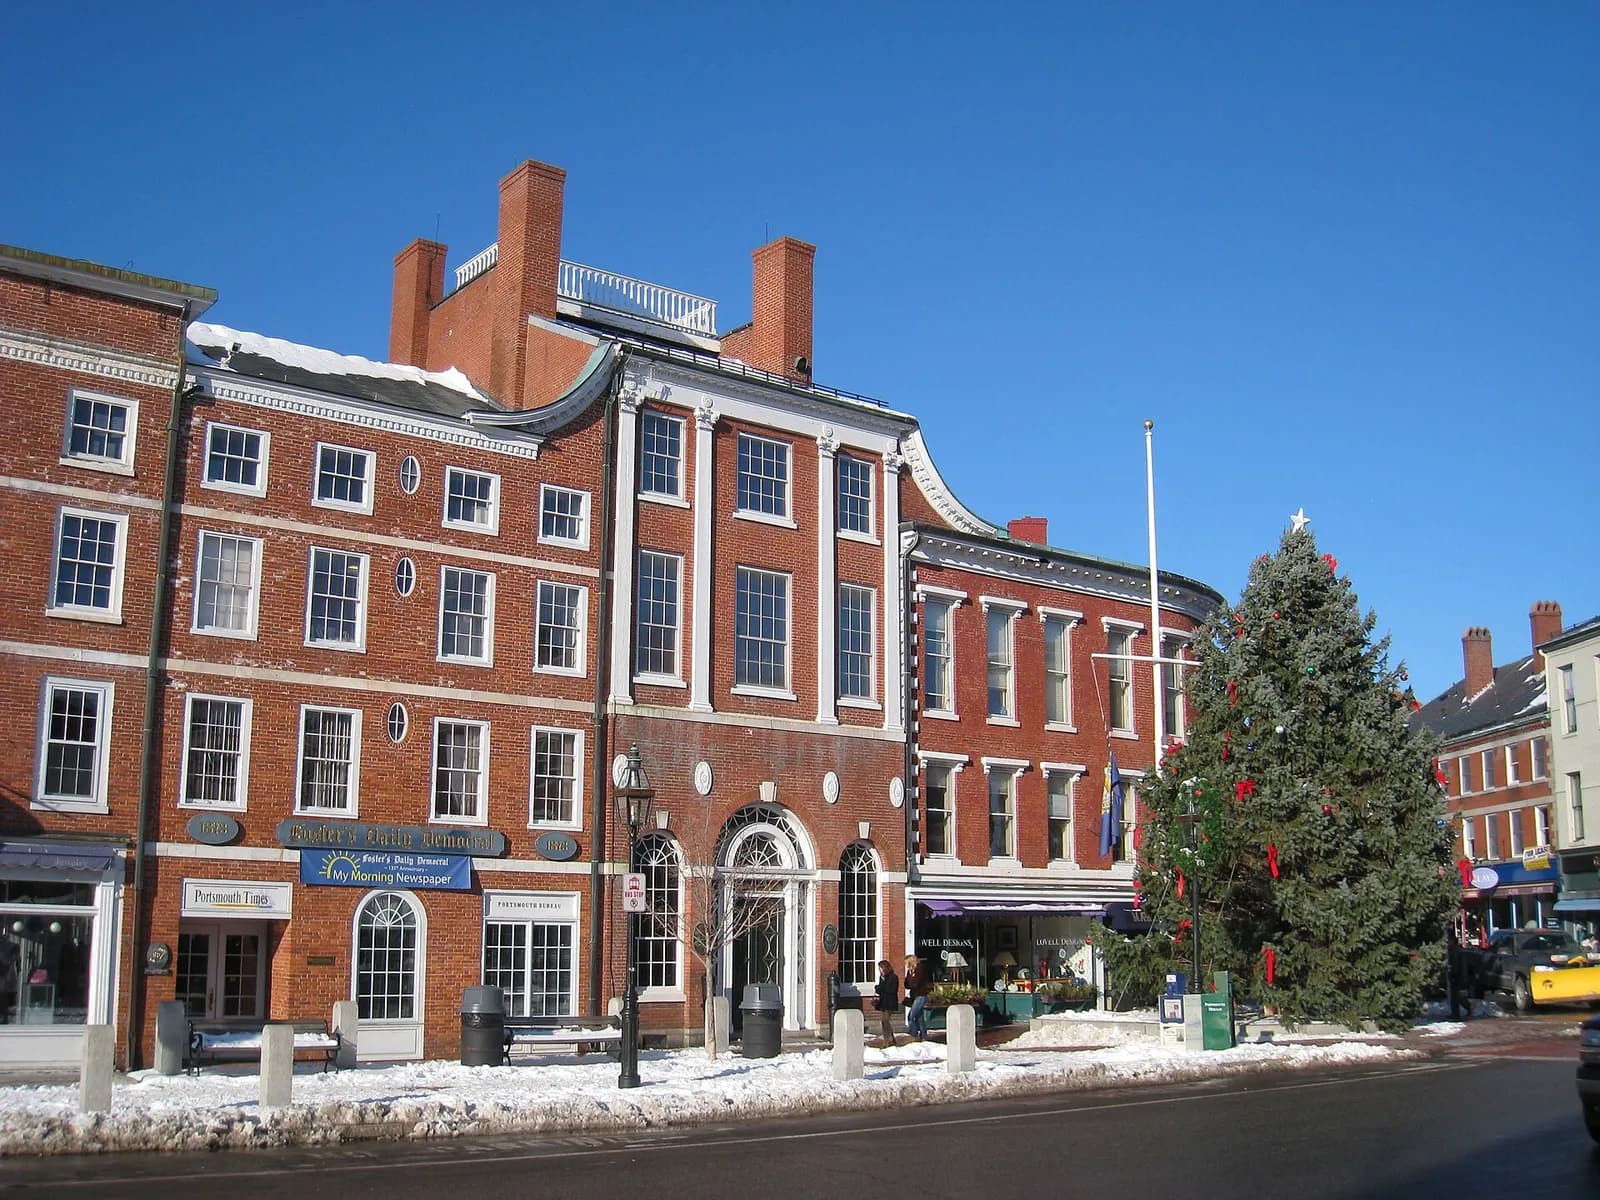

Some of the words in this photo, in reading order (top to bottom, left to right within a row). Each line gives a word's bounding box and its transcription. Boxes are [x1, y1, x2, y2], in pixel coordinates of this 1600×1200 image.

[288, 823, 356, 844] Foster's
[366, 826, 411, 849] Daily
[421, 829, 495, 850] Democrat
[362, 853, 390, 865] Foster's
[394, 855, 413, 867] Daily
[417, 856, 449, 867] Democrat
[333, 869, 349, 883] My
[351, 870, 394, 884] Morning
[396, 872, 452, 886] Newspaper
[195, 889, 241, 903] Portsmouth
[243, 891, 269, 905] Times
